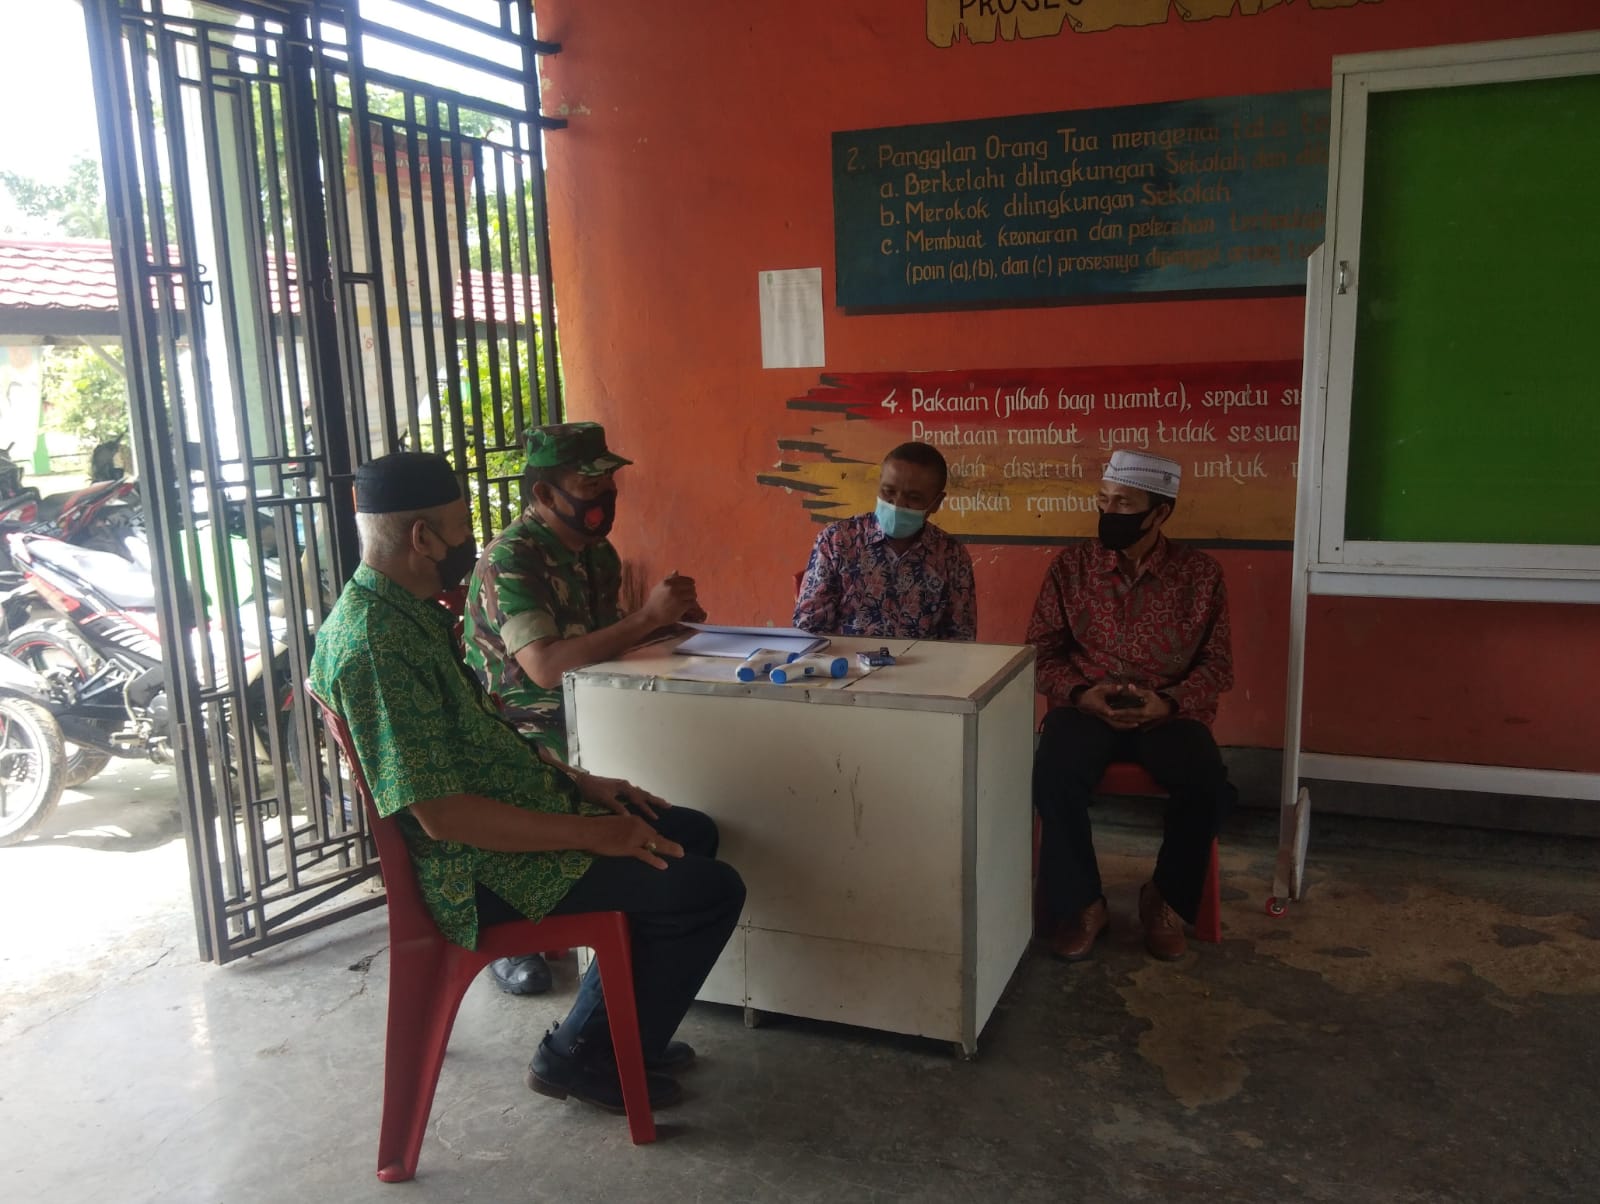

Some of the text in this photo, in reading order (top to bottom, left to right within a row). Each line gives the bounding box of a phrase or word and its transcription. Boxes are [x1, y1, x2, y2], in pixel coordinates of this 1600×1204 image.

[847, 147, 865, 171] 2.
[879, 140, 976, 169] Panggilan
[985, 135, 1048, 160] Orang
[1056, 128, 1098, 153] Tua
[1112, 126, 1220, 150] mengenai
[880, 182, 899, 198] a.
[904, 167, 1005, 196] Berkelahi
[1015, 158, 1155, 187] dilingkungan
[1166, 147, 1247, 176] Sekolah
[880, 176, 1231, 227] b. Merokok dilingkungan Sekolah
[880, 238, 899, 255] c.
[905, 226, 985, 252] Membuat
[998, 225, 1077, 247] keonaran
[1089, 218, 1123, 241] dan
[906, 262, 945, 287] (poin
[1001, 256, 1028, 276] dan
[1032, 255, 1053, 279] (c)
[1058, 253, 1139, 277] prosesnya
[881, 388, 904, 414] 4.
[911, 388, 989, 412] Pakaian
[995, 387, 1049, 418] (jilbab
[1058, 387, 1095, 416] bagi
[1104, 382, 1192, 413] wanita),
[1201, 384, 1268, 414] sepatu
[911, 419, 1298, 450] Penataan rambut yang tidak sesuai
[1003, 454, 1083, 479] disuruh
[1194, 452, 1267, 485] untuk
[940, 488, 1099, 518] rapikan rambut
